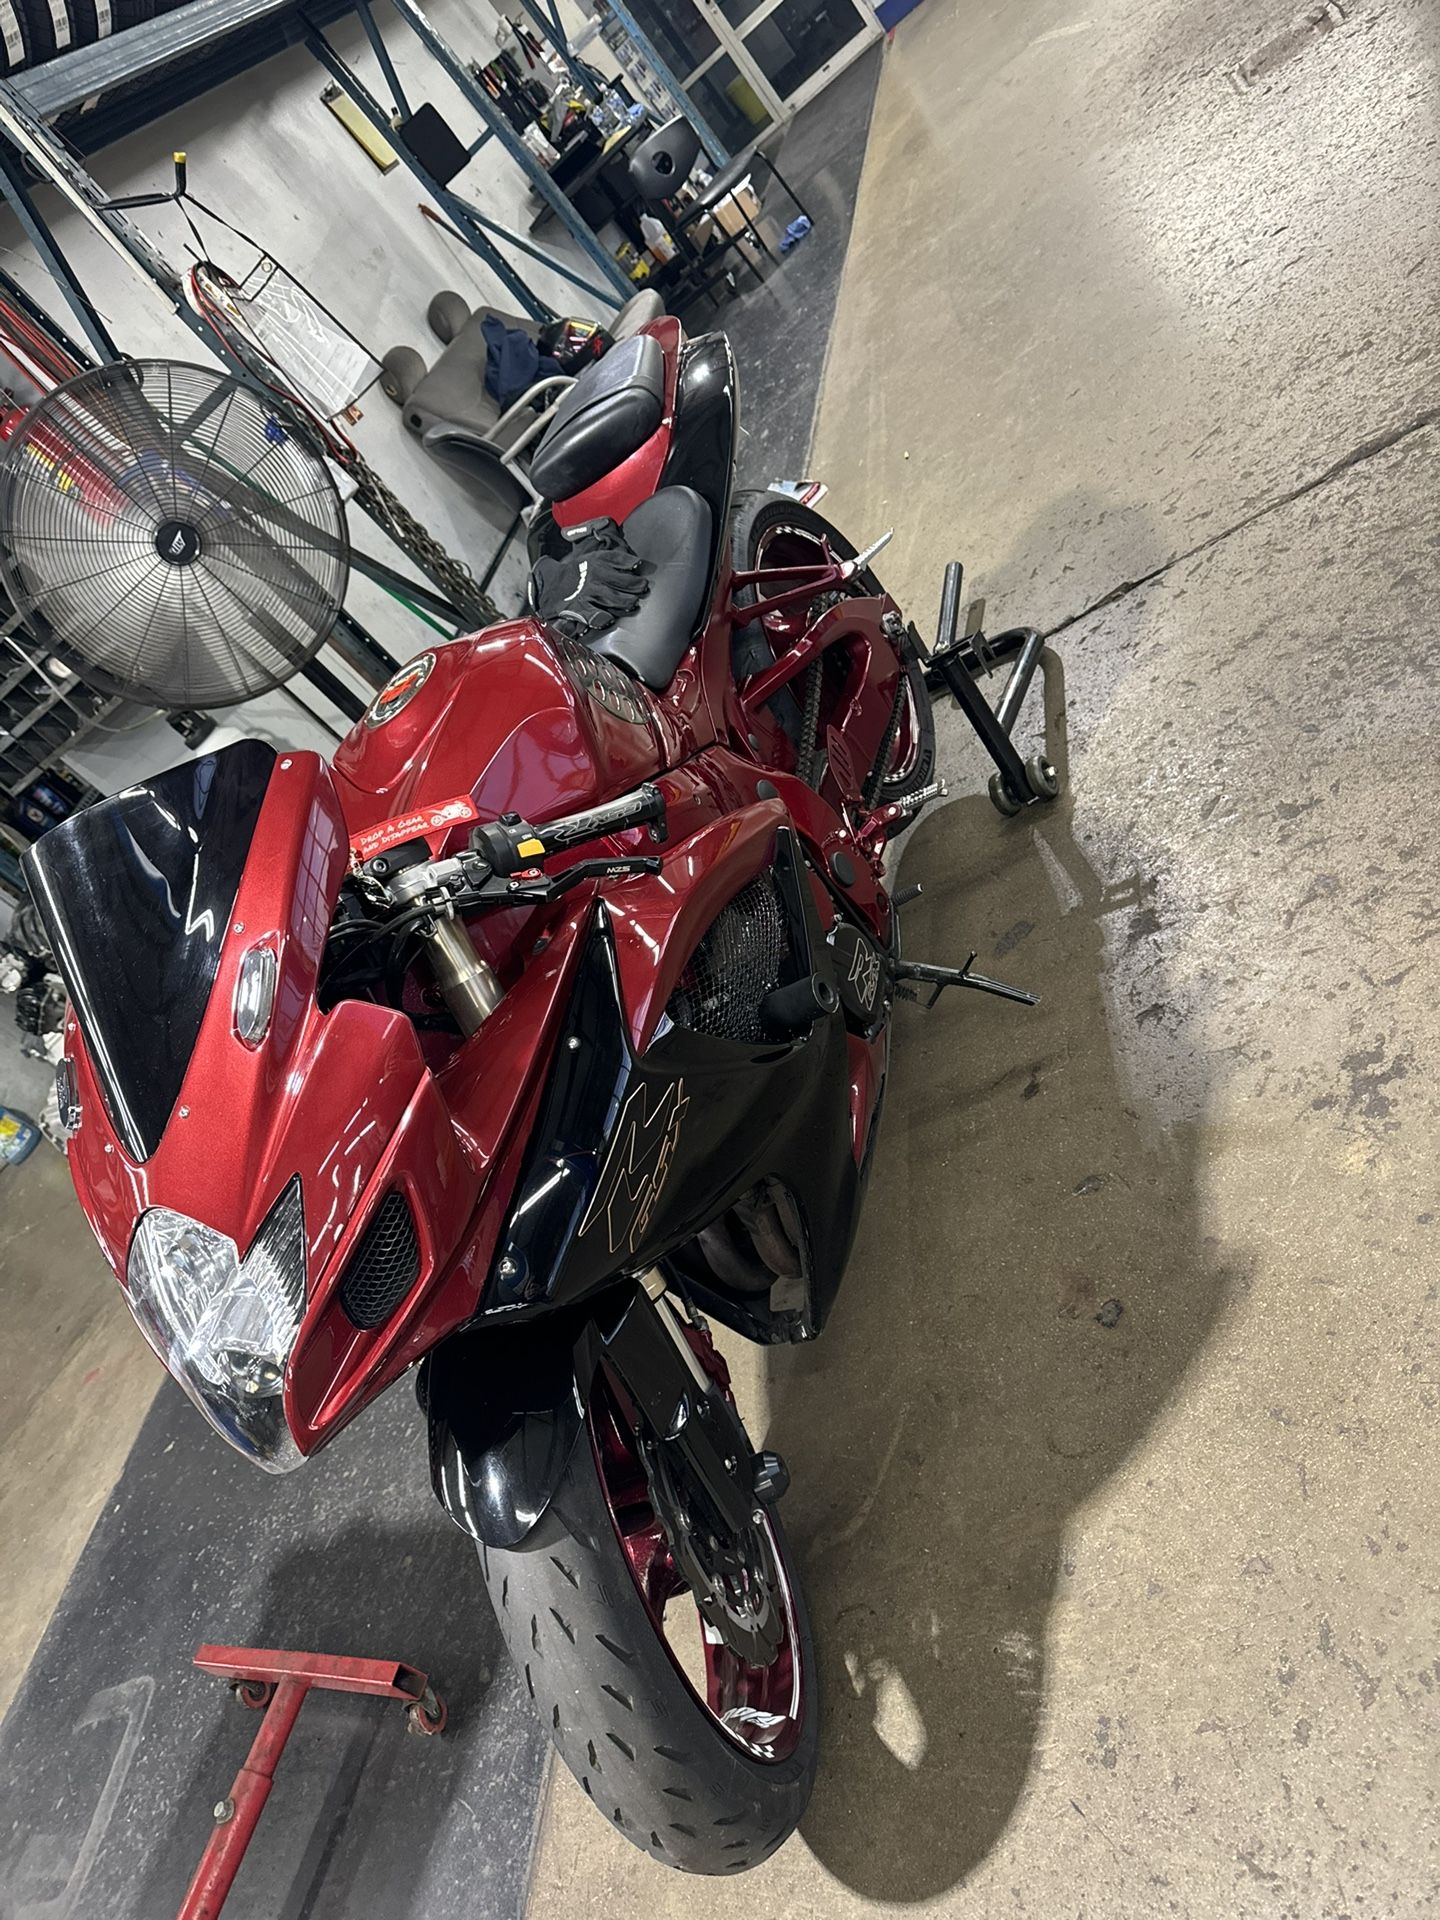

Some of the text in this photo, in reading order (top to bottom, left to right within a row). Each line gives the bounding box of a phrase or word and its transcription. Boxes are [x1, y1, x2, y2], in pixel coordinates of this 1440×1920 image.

[360, 815, 425, 846] DROP A GEAR
[606, 865, 631, 874] MZS
